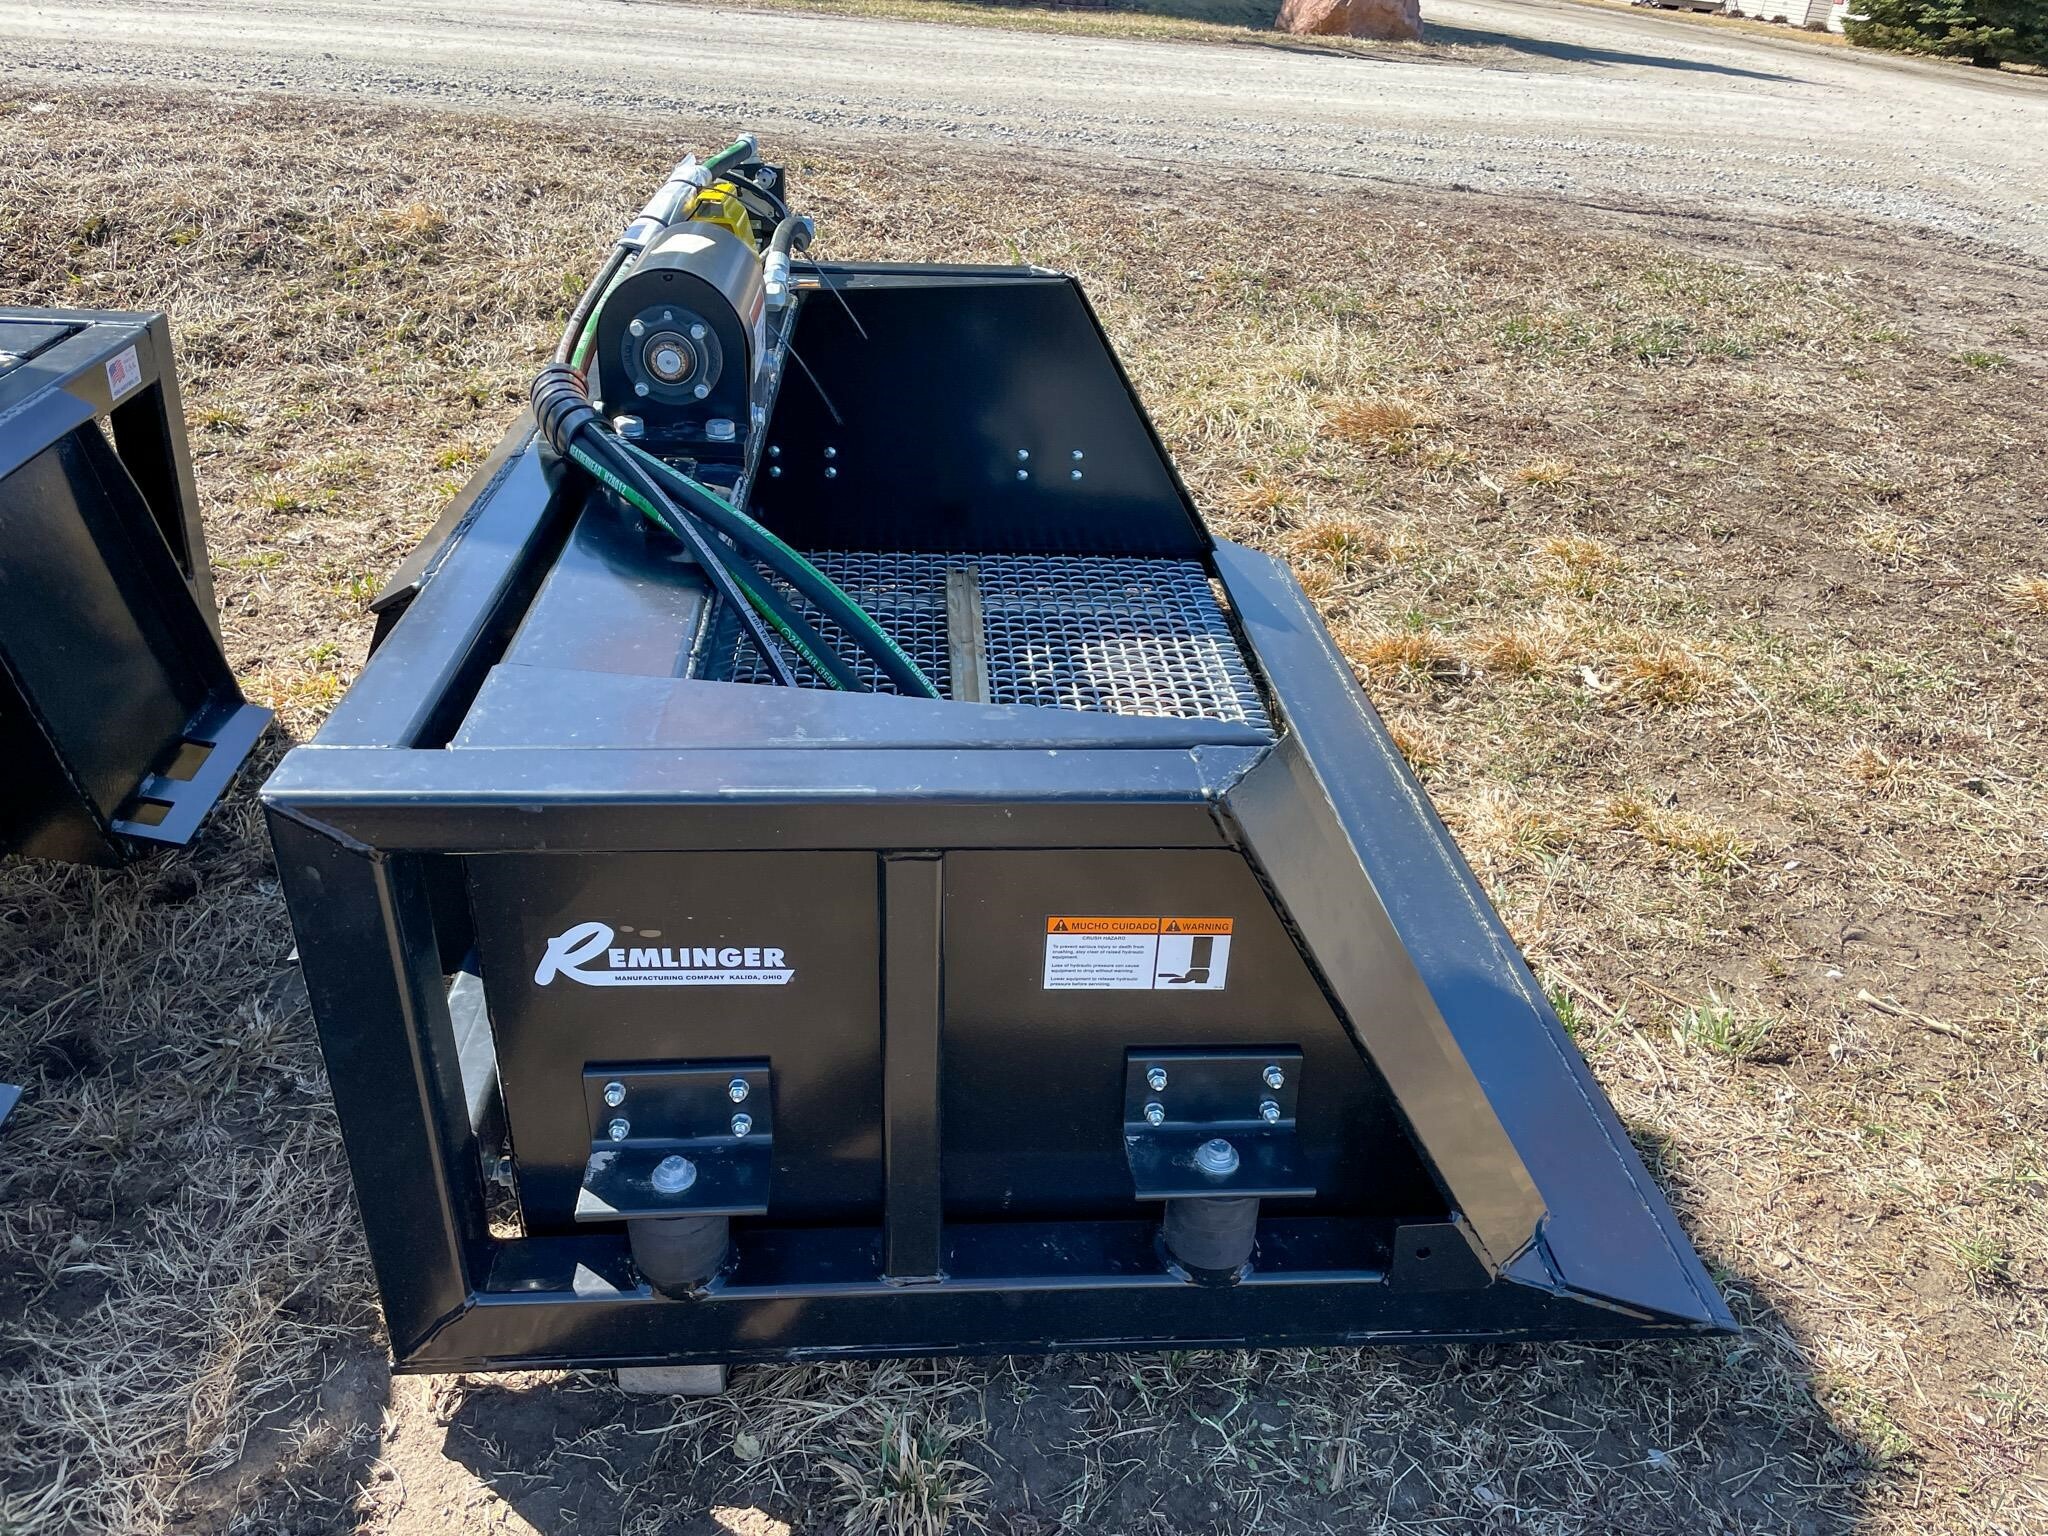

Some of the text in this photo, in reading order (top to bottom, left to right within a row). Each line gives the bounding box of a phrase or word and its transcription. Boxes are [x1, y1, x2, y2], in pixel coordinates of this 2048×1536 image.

[789, 635, 801, 651] 241
[802, 650, 818, 666] BAR
[881, 632, 895, 647] 241
[895, 645, 910, 665] BAR
[1072, 922, 1109, 930] MUCHO
[534, 922, 786, 986] REMLINGER
